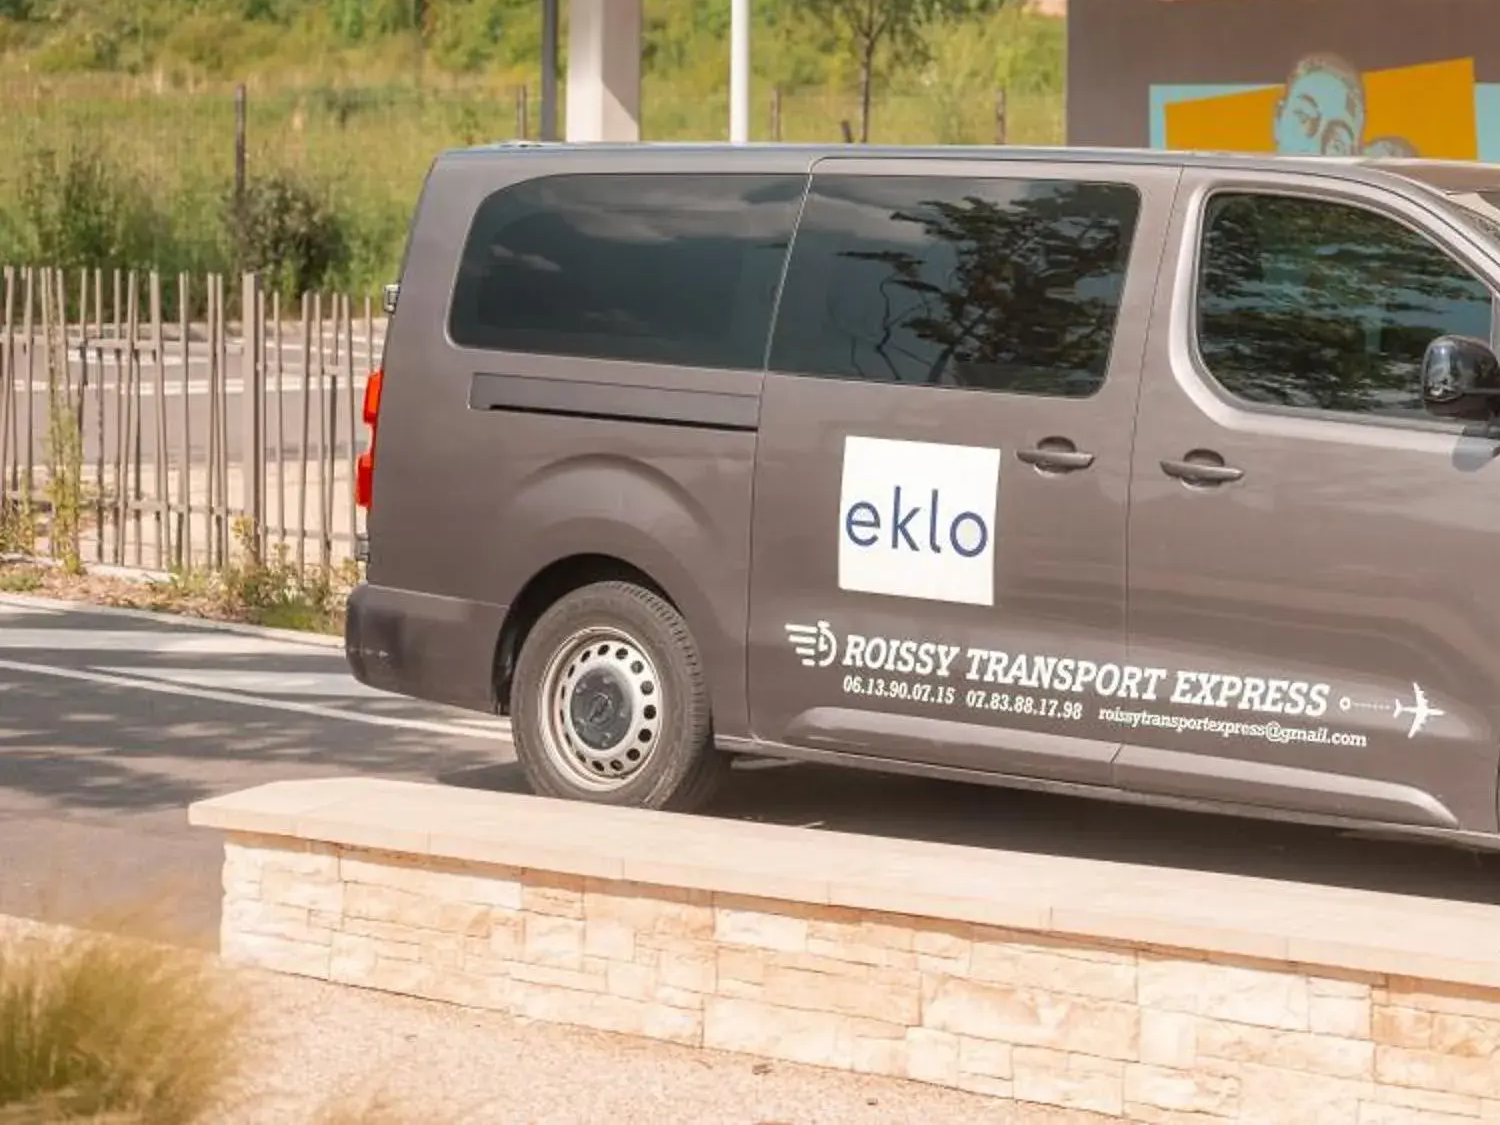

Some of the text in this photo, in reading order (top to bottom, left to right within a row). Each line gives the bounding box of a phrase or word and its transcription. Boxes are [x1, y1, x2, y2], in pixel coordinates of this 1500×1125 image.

[846, 485, 988, 557] eklo
[842, 635, 1330, 716] ROISSY TRANSPORT EXPRESS
[843, 676, 1367, 747] 06.13.90.07.15 07.83.88.17.98 roissytransportexpress@gmail.com
